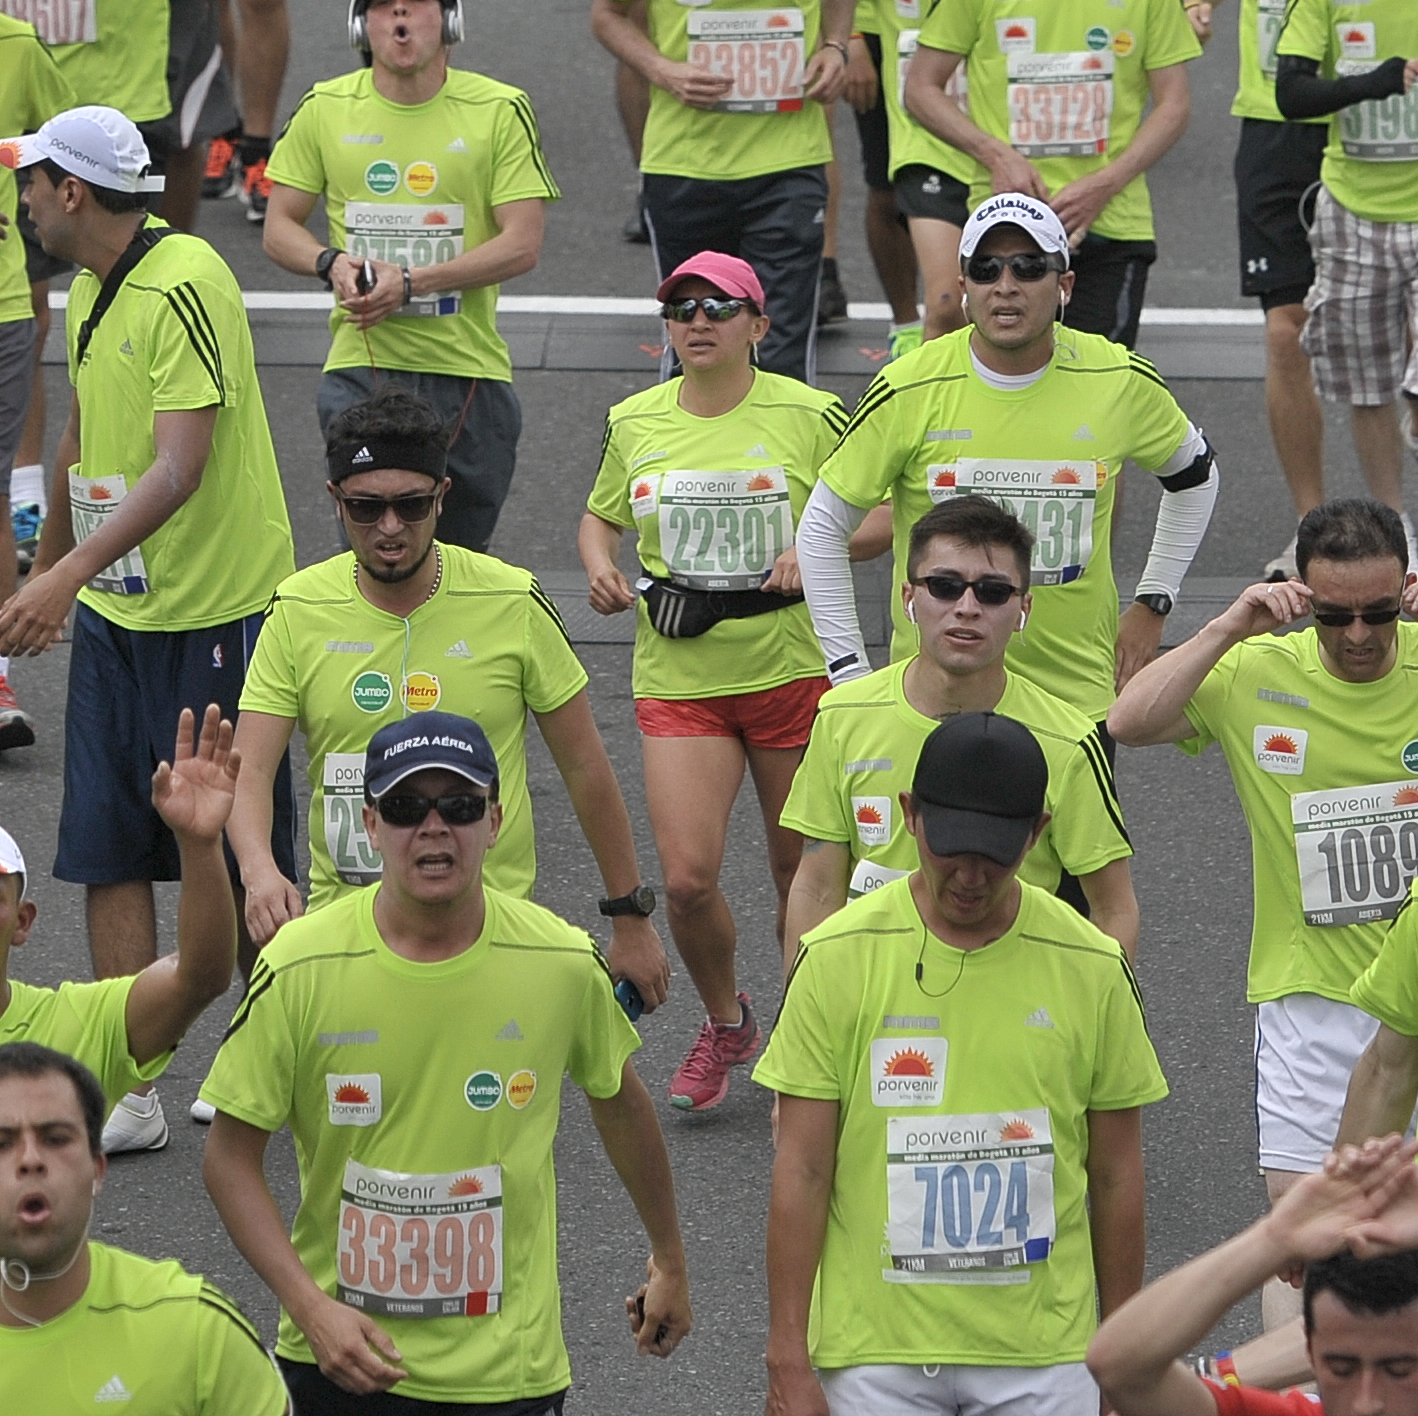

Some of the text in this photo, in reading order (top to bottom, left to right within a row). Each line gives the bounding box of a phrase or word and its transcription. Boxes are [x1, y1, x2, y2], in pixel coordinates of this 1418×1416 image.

[48, 137, 99, 169] porvenir
[976, 197, 1044, 221] Callaway
[355, 212, 413, 227] porvenir
[674, 479, 737, 494] porvenir
[972, 469, 1043, 486] porvenir
[669, 505, 782, 572] 22301
[353, 686, 390, 698] JUMBO
[402, 686, 439, 698] Metro
[384, 735, 474, 761] FUERZA AÉREA
[1257, 750, 1301, 765] porvenir
[1307, 794, 1382, 819] porvenir
[1307, 821, 1331, 831] media
[1332, 817, 1363, 829] maratón
[1364, 814, 1374, 825] de
[1374, 812, 1401, 825] Bogotá
[1401, 810, 1411, 820] 15
[466, 1085, 499, 1096] JUMBO
[507, 1082, 536, 1097] Metro
[877, 1077, 939, 1095] porvenir
[331, 1102, 377, 1116] porvenir
[905, 1126, 988, 1151] porvenir
[903, 1145, 1041, 1163] media maratón de Bogotá 15 años
[355, 1177, 436, 1201] porvenir
[913, 1160, 1030, 1248] 7024
[339, 1205, 496, 1296] 33398
